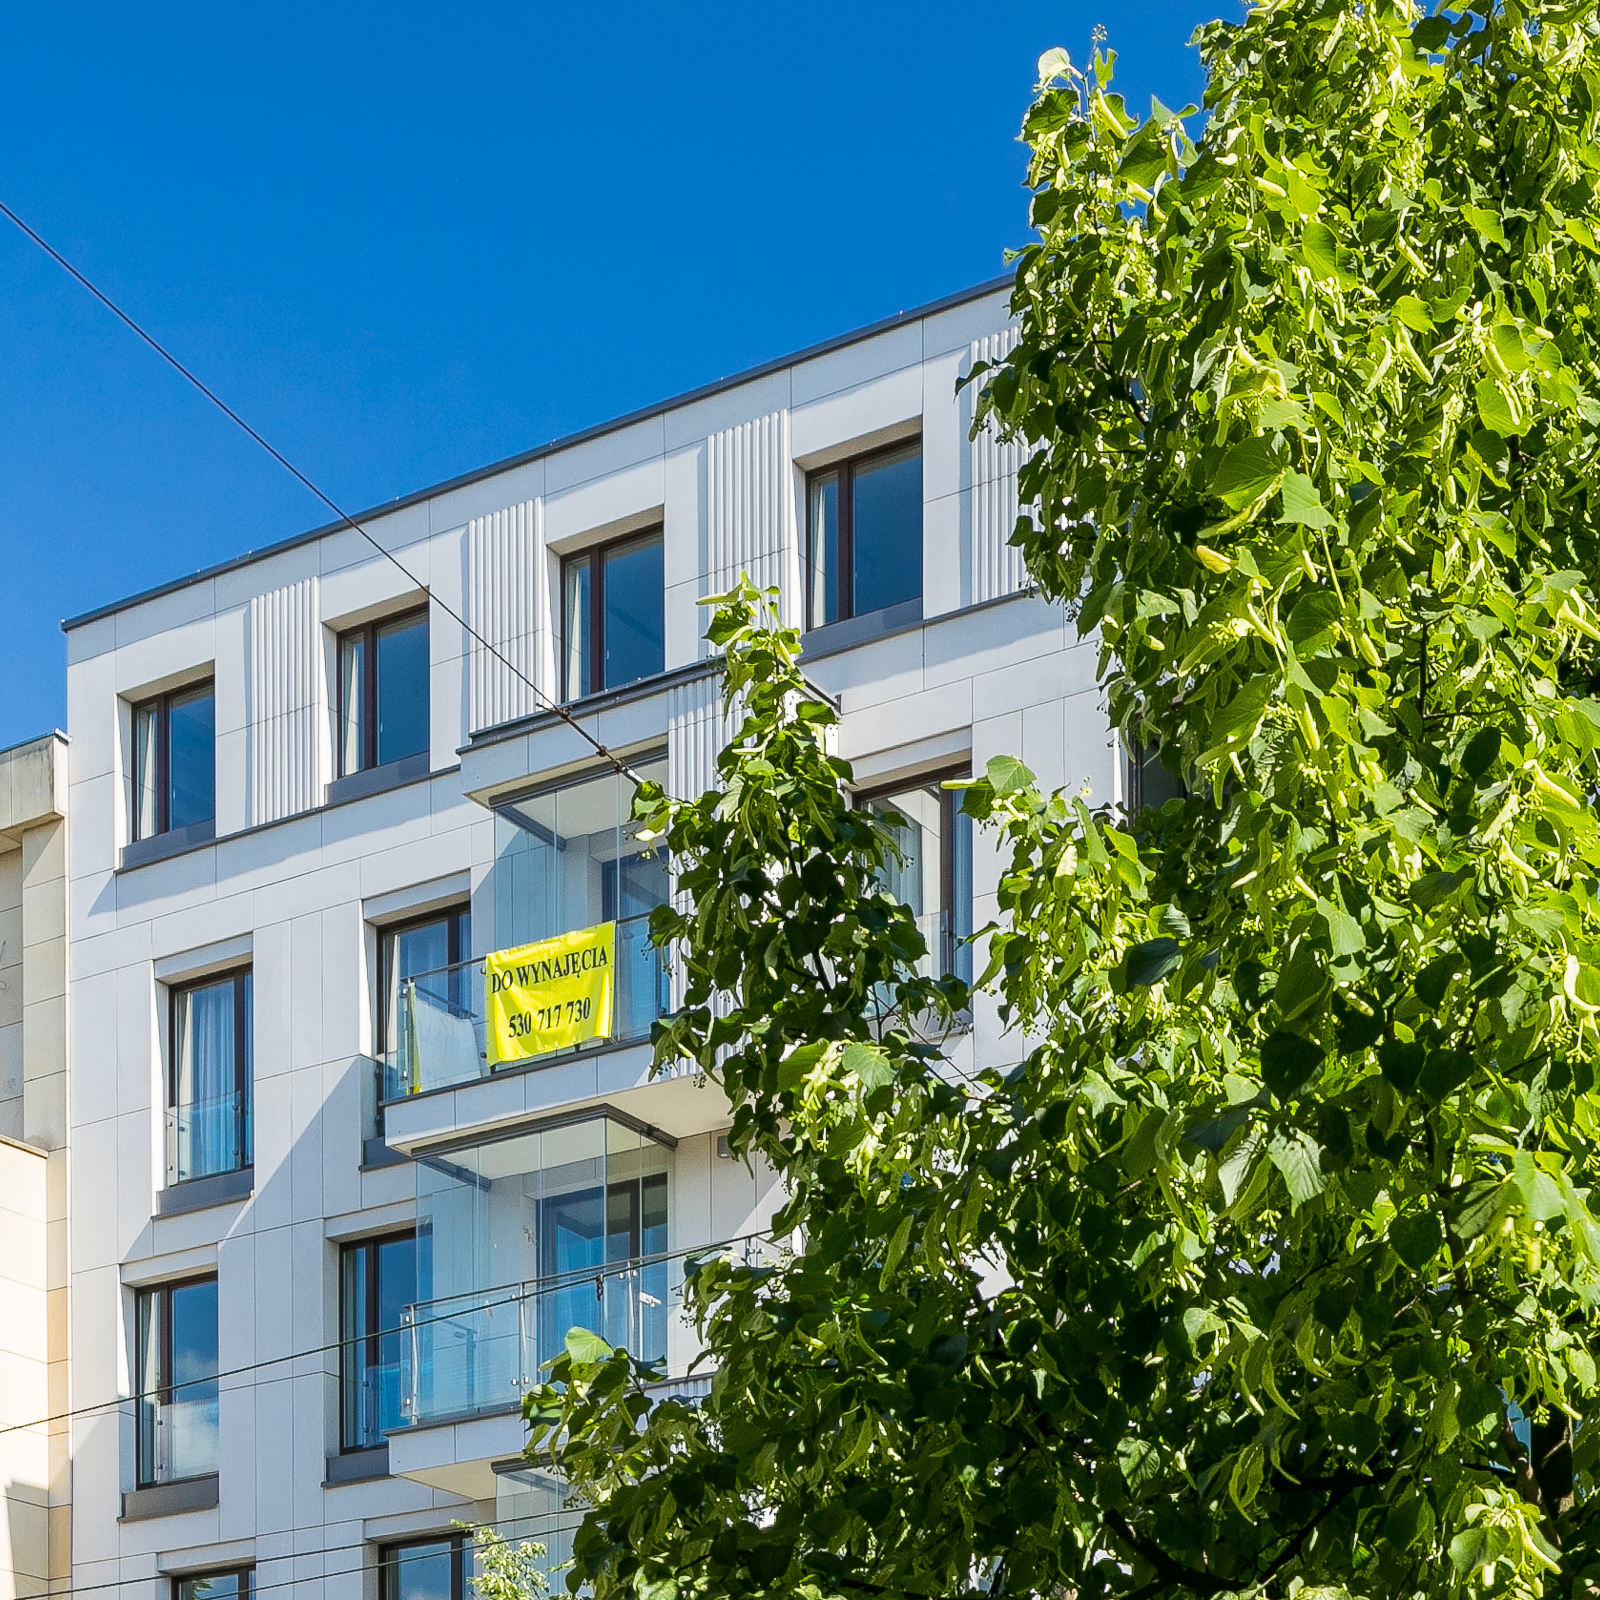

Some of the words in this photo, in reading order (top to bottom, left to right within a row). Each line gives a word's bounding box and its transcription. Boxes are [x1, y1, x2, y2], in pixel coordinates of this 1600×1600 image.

[491, 969, 514, 994] DO
[516, 945, 608, 987] WYNAJĘCIA
[508, 1011, 532, 1038] 530
[537, 1004, 561, 1031] 717
[565, 997, 591, 1023] 730
